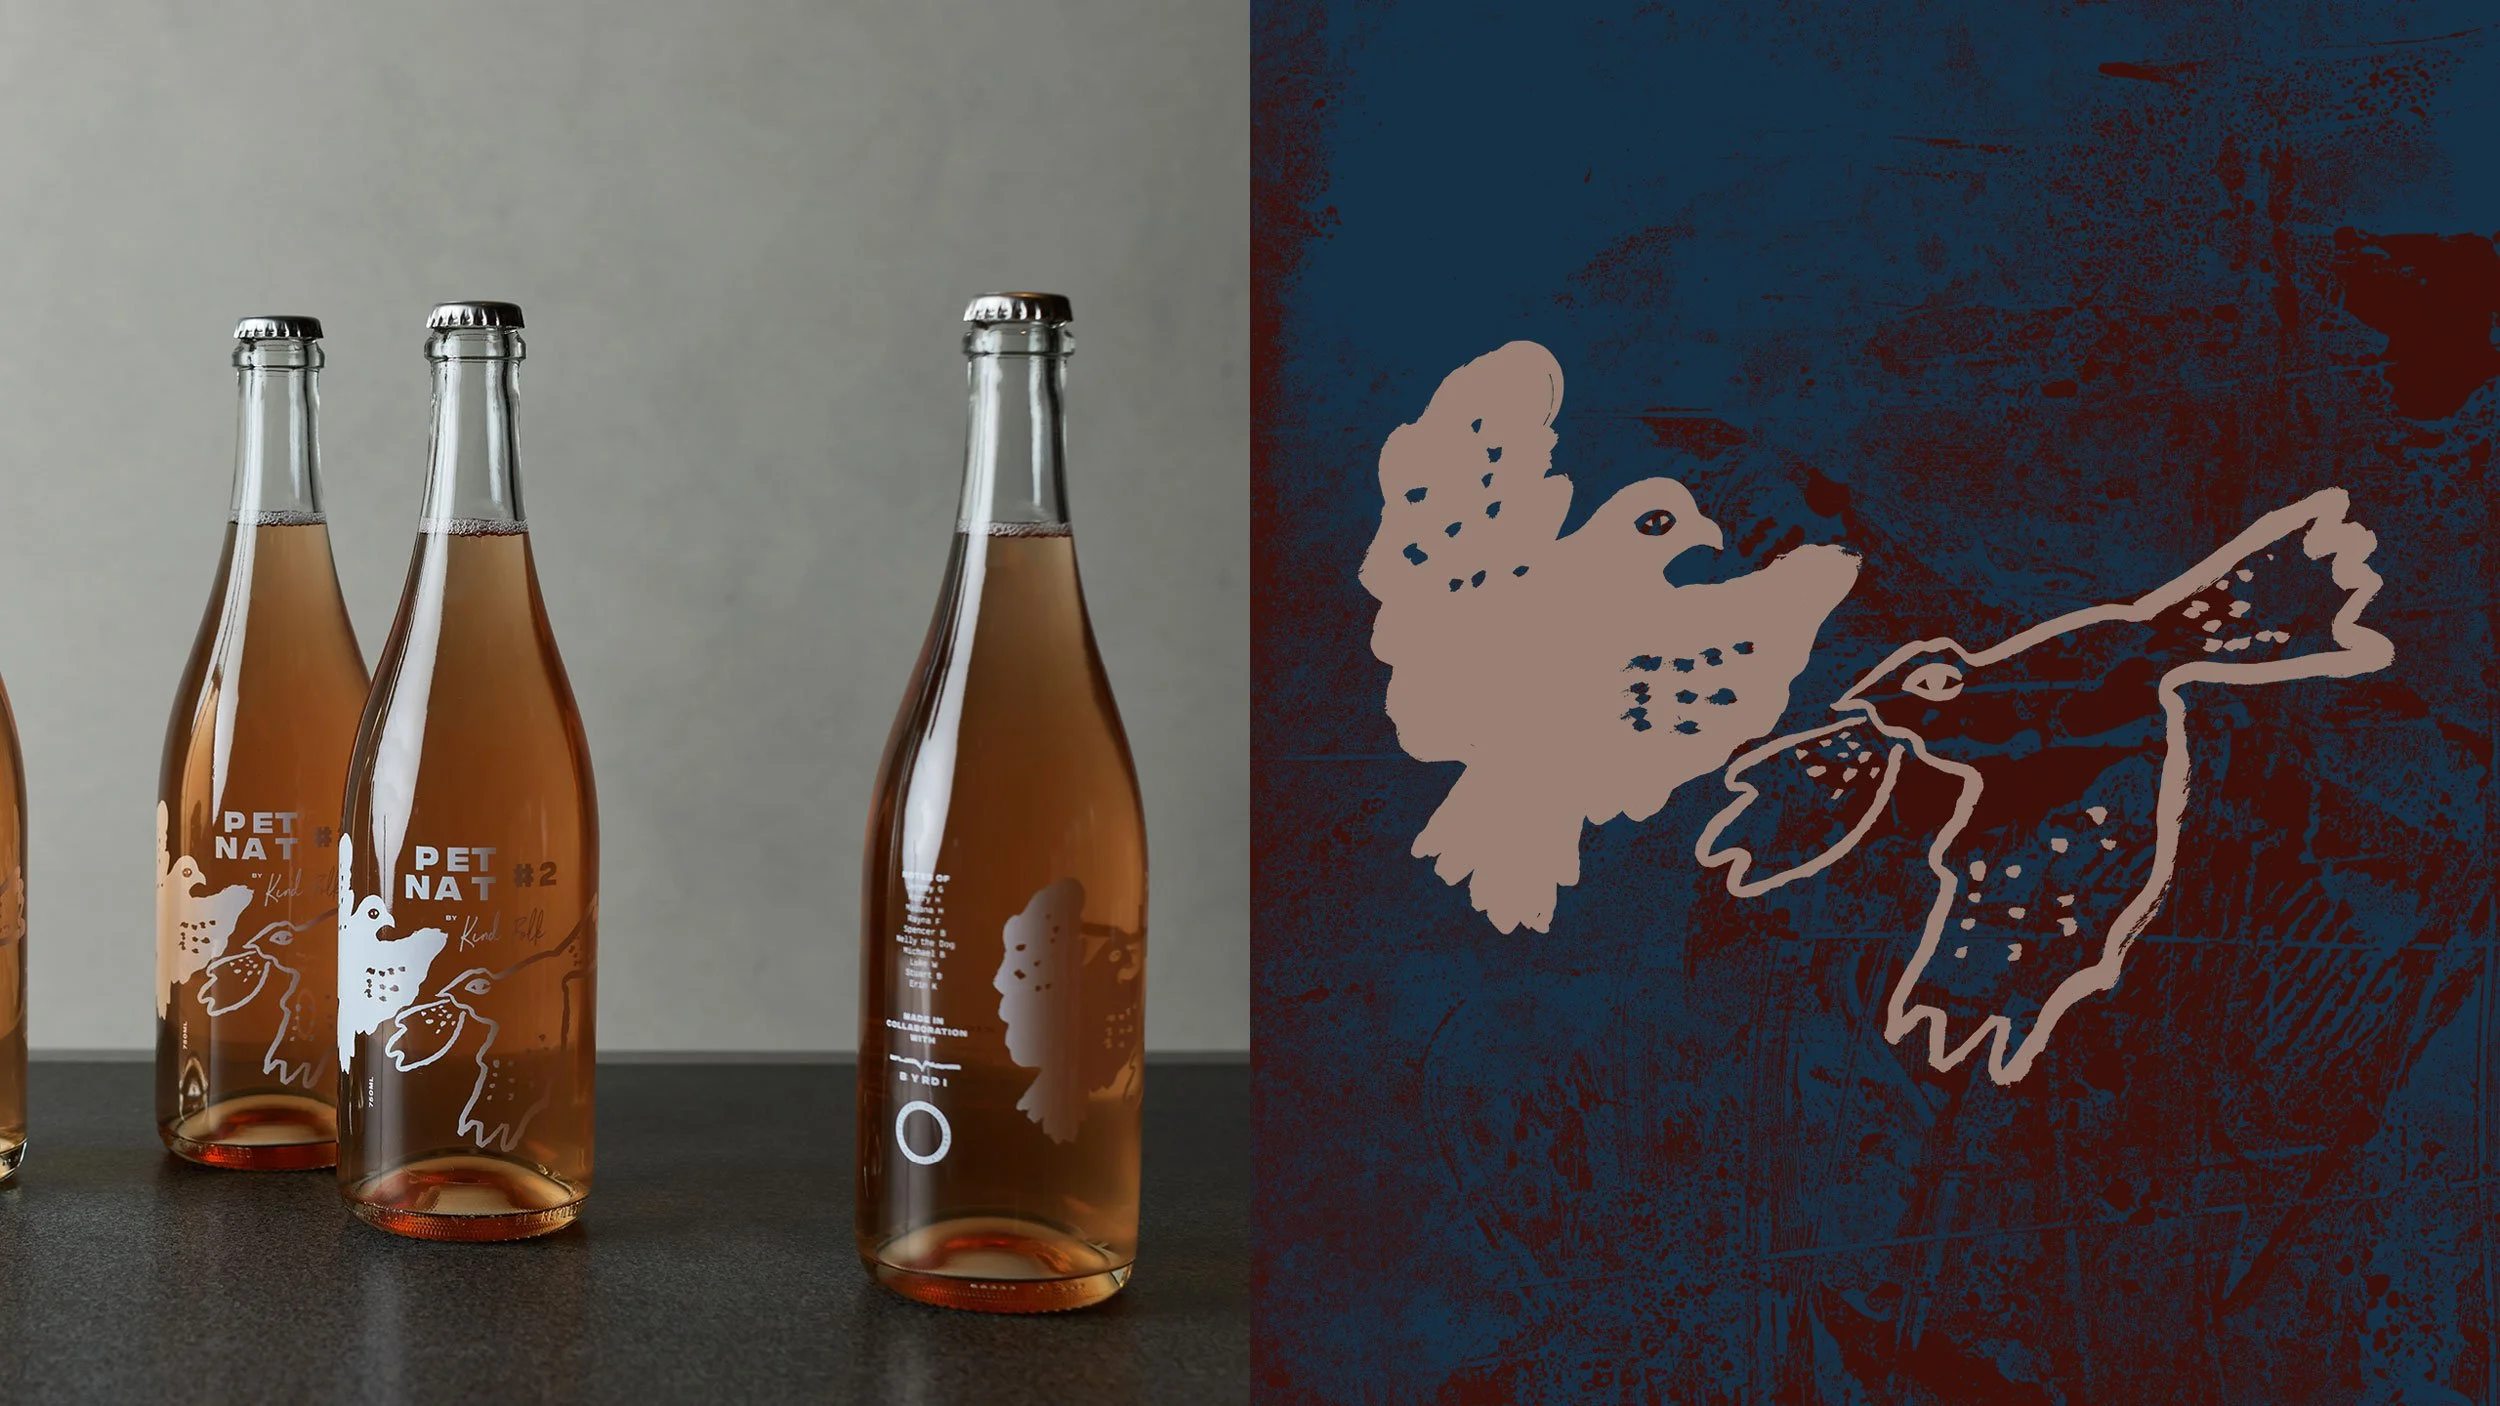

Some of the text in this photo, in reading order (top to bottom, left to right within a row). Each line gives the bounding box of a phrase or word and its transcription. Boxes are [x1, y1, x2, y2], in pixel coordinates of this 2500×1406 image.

[224, 811, 297, 834] PET
[215, 836, 297, 860] NAT
[415, 845, 497, 872] PET
[513, 862, 557, 887] #2
[264, 868, 304, 907] Kind
[405, 874, 497, 901] NAT
[445, 914, 458, 922] BY
[459, 909, 502, 952] Kind
[903, 924, 936, 936] Spencer
[920, 938, 936, 948] the
[939, 939, 956, 951] Dog
[886, 1019, 968, 1038] COLLABORATION
[903, 1012, 944, 1025] MADE IN
[909, 1033, 936, 1045] WITH
[899, 1071, 948, 1087] BYRDI
